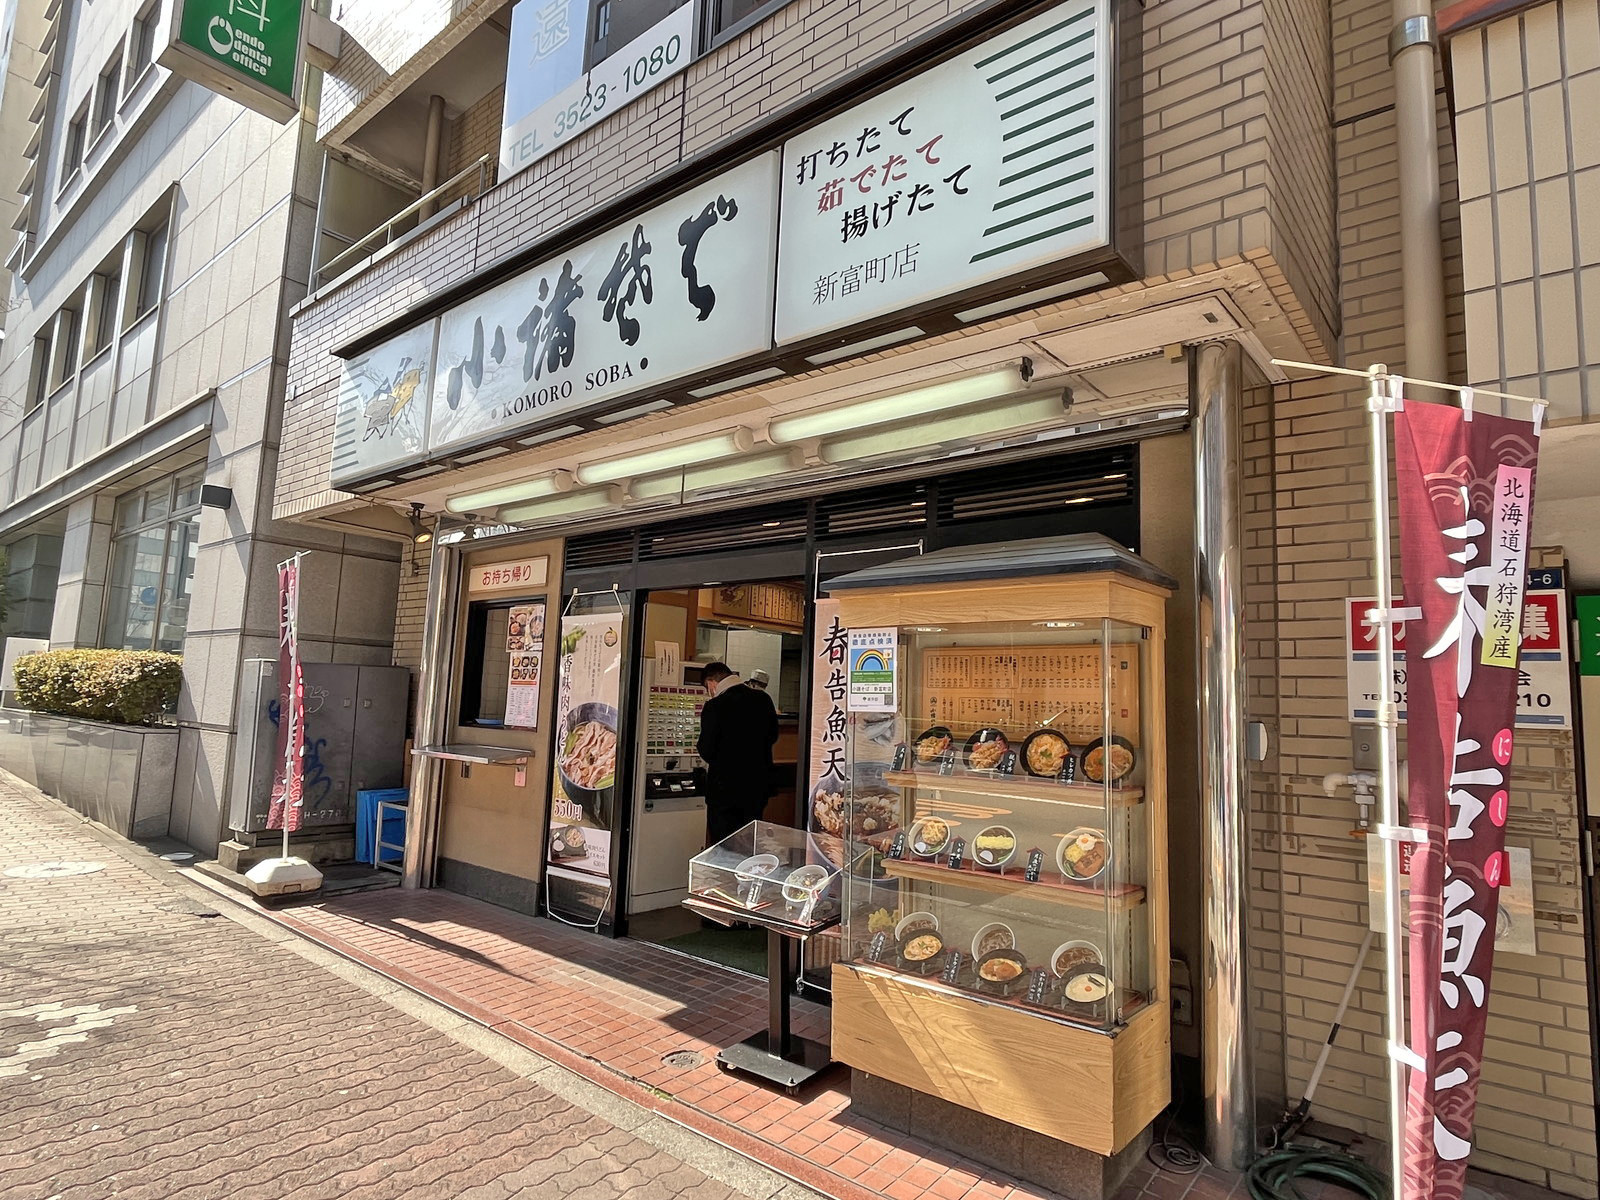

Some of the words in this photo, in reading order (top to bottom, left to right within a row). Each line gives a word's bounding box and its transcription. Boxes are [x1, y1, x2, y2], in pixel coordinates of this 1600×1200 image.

[232, 52, 267, 76] office
[233, 40, 272, 67] dental
[234, 28, 265, 51] endo
[509, 128, 543, 167] TEL
[553, 34, 681, 139] 3523-1080
[796, 106, 915, 185] 打ちたて
[817, 134, 943, 216] 茹でたて
[841, 164, 972, 244] 揚げたて
[812, 243, 921, 306] 新富町店
[502, 380, 573, 418] KOMORO
[585, 360, 634, 391] SOBA
[482, 564, 532, 587] お持ち帰り
[1489, 476, 1525, 660] 北海道石狩湾産
[818, 616, 851, 782] 春告魚天
[554, 799, 583, 822] 550円
